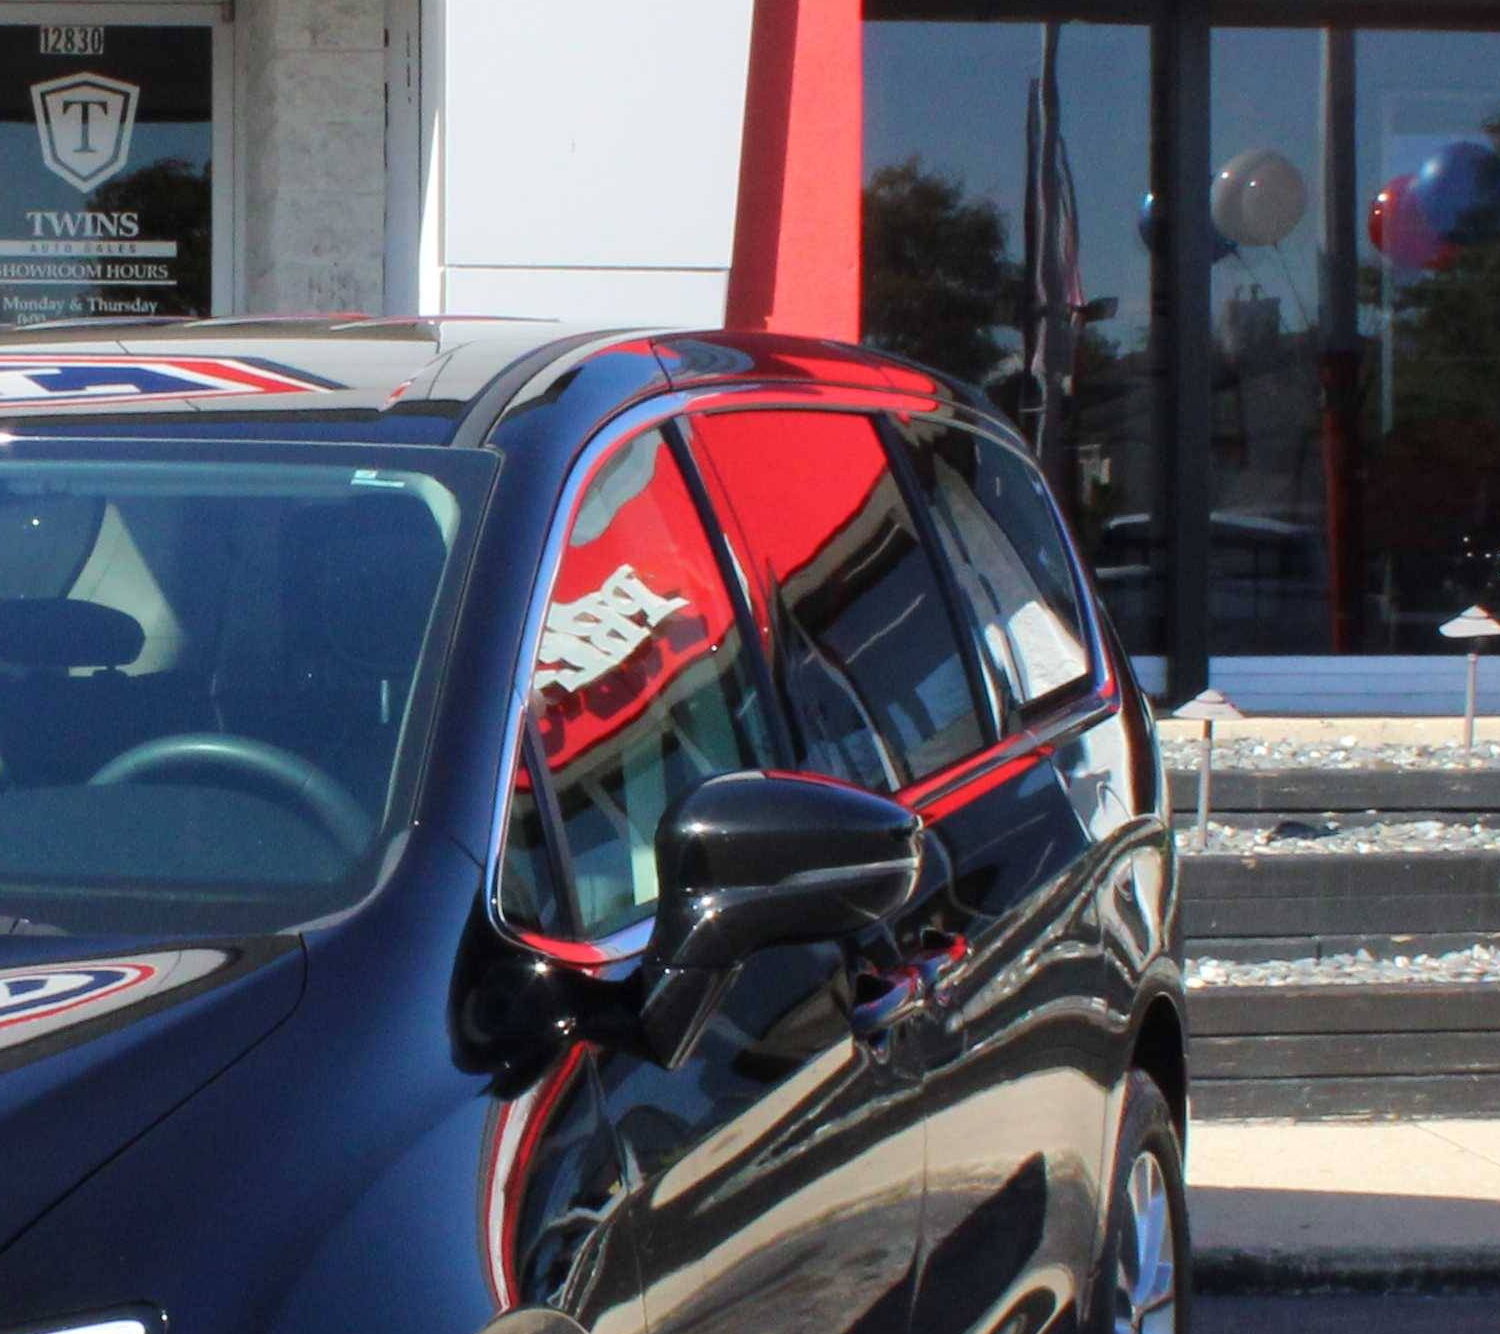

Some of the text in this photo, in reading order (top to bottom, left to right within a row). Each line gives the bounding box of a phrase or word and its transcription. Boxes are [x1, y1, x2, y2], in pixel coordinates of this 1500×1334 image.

[41, 27, 103, 54] 12830
[62, 100, 108, 153] T
[27, 211, 140, 237] TWINS
[29, 243, 137, 254] AUTO SALES
[106, 263, 169, 279] HOURS
[3, 296, 159, 315] Monday & Thursday
